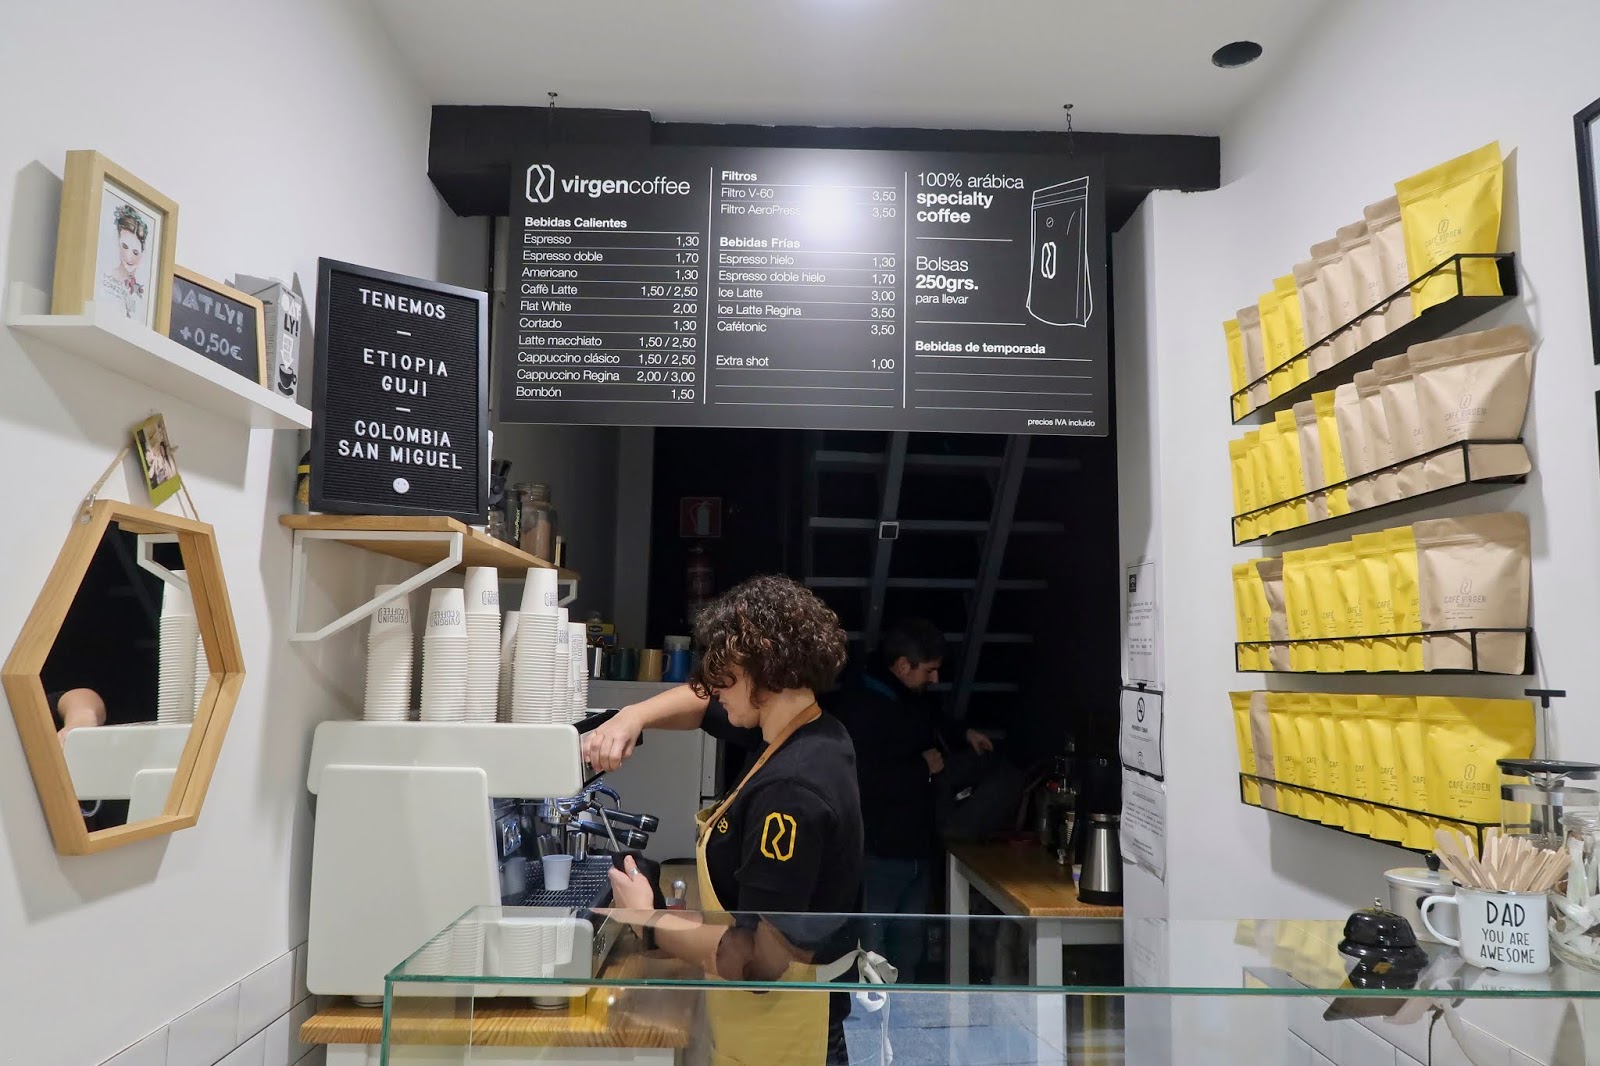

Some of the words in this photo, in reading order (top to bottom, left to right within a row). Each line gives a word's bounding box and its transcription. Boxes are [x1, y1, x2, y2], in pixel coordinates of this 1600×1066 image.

[722, 171, 758, 181] Filtros
[917, 172, 963, 188] 100%
[967, 174, 1024, 189] arábica
[561, 175, 691, 198] virgencoffee
[721, 188, 746, 198] Filtro
[749, 189, 774, 198] V-60
[872, 191, 896, 202] 3,50
[916, 191, 994, 209] specialty
[720, 204, 745, 214] Filtro
[748, 205, 801, 215] AeroPress
[872, 208, 896, 219] 3,50
[916, 208, 971, 223] coffee
[525, 217, 571, 228] Bebidas
[574, 218, 627, 229] Calientes
[524, 234, 571, 245] Espresso
[676, 236, 700, 247] 1,30
[720, 237, 768, 247] Bebidas
[771, 238, 801, 249] Frías
[523, 251, 571, 261] Espresso
[574, 251, 603, 262] doble
[676, 253, 699, 264] 1,70
[719, 254, 768, 265] Espresso
[770, 255, 794, 265] hielo
[872, 257, 896, 269] 1,30
[916, 256, 969, 272] Bolsas
[522, 268, 578, 278] Americano
[675, 270, 699, 281] 1,30
[718, 271, 767, 281] Espresso
[770, 271, 799, 282] doble
[802, 272, 826, 283] hielo
[872, 274, 896, 286] 1,70
[915, 275, 979, 293] 250grs.
[521, 284, 549, 295] Caffè
[551, 284, 578, 295] Latte
[641, 286, 664, 298] 1,50
[674, 287, 698, 298] 2,50
[718, 288, 734, 298] Ice
[736, 288, 763, 298] Latte
[871, 291, 895, 302] 3,00
[915, 294, 940, 305] para
[942, 294, 969, 305] llevar
[359, 288, 446, 319] TENEMOS
[520, 301, 539, 311] Flat
[542, 301, 572, 312] White
[673, 303, 697, 315] 2,00
[717, 305, 733, 315] Ice
[736, 305, 762, 315] Latte
[765, 306, 802, 318] Regina
[871, 308, 895, 319] 3,50
[283, 312, 299, 337] LY!
[519, 318, 562, 329] Cortado
[673, 320, 697, 332] 1,30
[717, 321, 767, 332] Cafétonic
[871, 325, 895, 336] 3,50
[180, 326, 243, 361] +0,50€
[518, 335, 545, 345] Latte
[547, 336, 602, 347] macchiato
[639, 337, 663, 349] 1,50
[672, 337, 696, 348] 2,50
[915, 341, 962, 352] Bebidas
[965, 342, 980, 353] de
[983, 343, 1046, 355] temporada
[363, 348, 448, 377] ETIOPIA
[518, 352, 581, 364] Cappuccino
[584, 353, 620, 364] clásico
[638, 354, 662, 366] 1,50
[672, 354, 696, 365] 2,50
[716, 355, 743, 366] Extra
[746, 356, 769, 367] shot
[871, 359, 895, 371] 1,00
[517, 369, 580, 381] Cappuccino
[583, 370, 620, 383] Regina
[637, 371, 661, 383] 2,00
[671, 372, 695, 383] 3,00
[381, 376, 427, 397] GUJI
[516, 387, 562, 397] Bombón
[671, 389, 695, 401] 1,50
[1027, 419, 1053, 427] precios
[1068, 419, 1095, 427] incluido
[355, 420, 451, 447] COLOMBIA
[338, 440, 378, 460] SAN
[391, 446, 462, 469] MIGUEL
[1486, 901, 1525, 927] DAD
[1482, 928, 1504, 944] YOU
[1510, 933, 1529, 946] ARE
[1480, 944, 1535, 963] AWESOME
